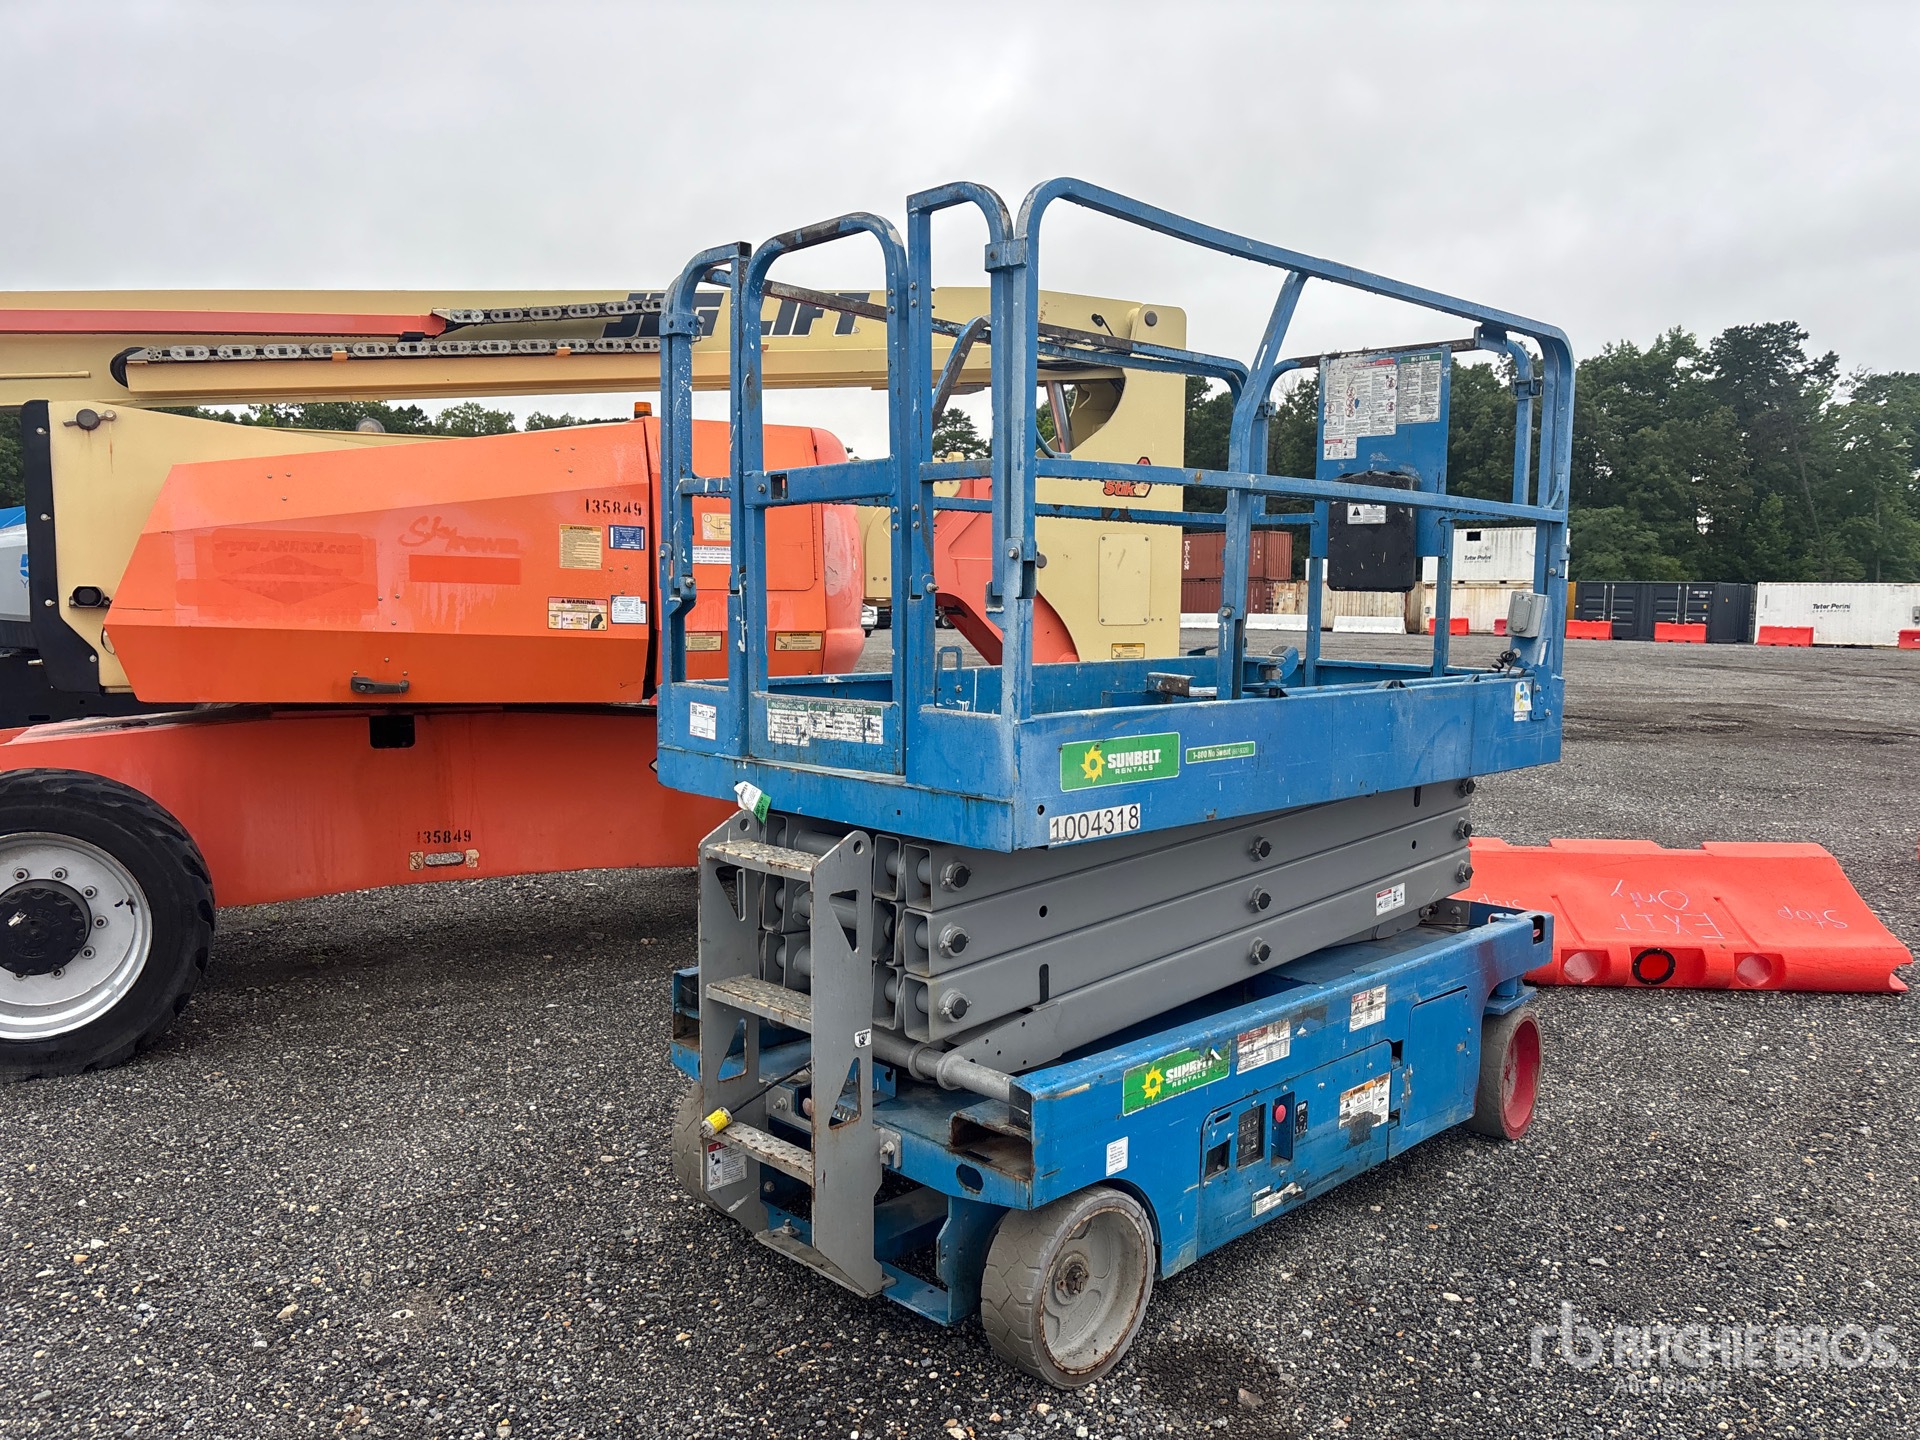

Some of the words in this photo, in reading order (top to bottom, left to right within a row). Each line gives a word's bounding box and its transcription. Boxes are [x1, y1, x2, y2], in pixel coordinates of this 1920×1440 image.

[585, 498, 642, 516] 135849
[1107, 749, 1160, 768] SUNBELT
[1216, 748, 1231, 757] Sweat
[1115, 765, 1154, 775] RENTALS
[1051, 805, 1139, 841] 1004318
[417, 829, 471, 845] 135849
[1615, 912, 1725, 939] EXIT
[1777, 905, 1848, 929] Stop
[1172, 1070, 1207, 1088] RENTALS
